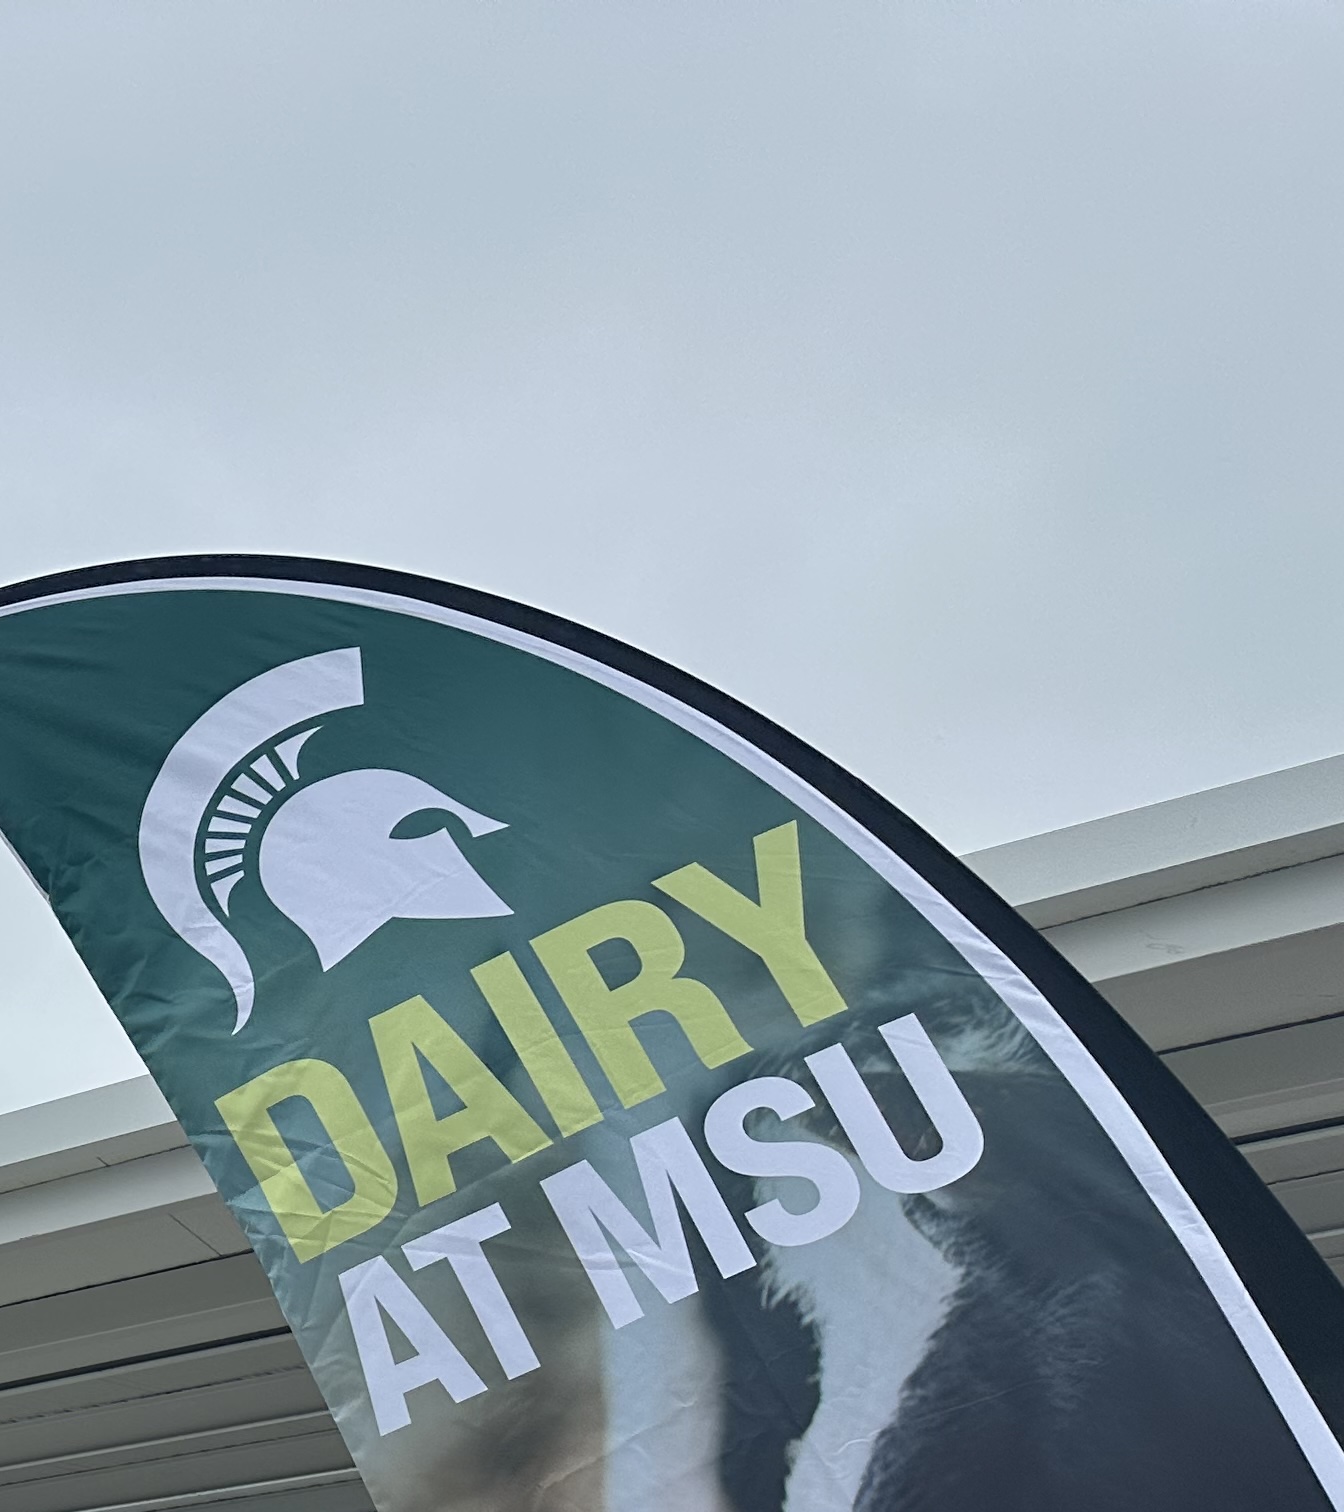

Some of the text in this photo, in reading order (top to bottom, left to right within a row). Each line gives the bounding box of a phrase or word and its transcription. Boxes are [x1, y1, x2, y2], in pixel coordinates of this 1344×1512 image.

[215, 820, 848, 1264] DAIRY
[338, 1012, 984, 1437] AT MSU
